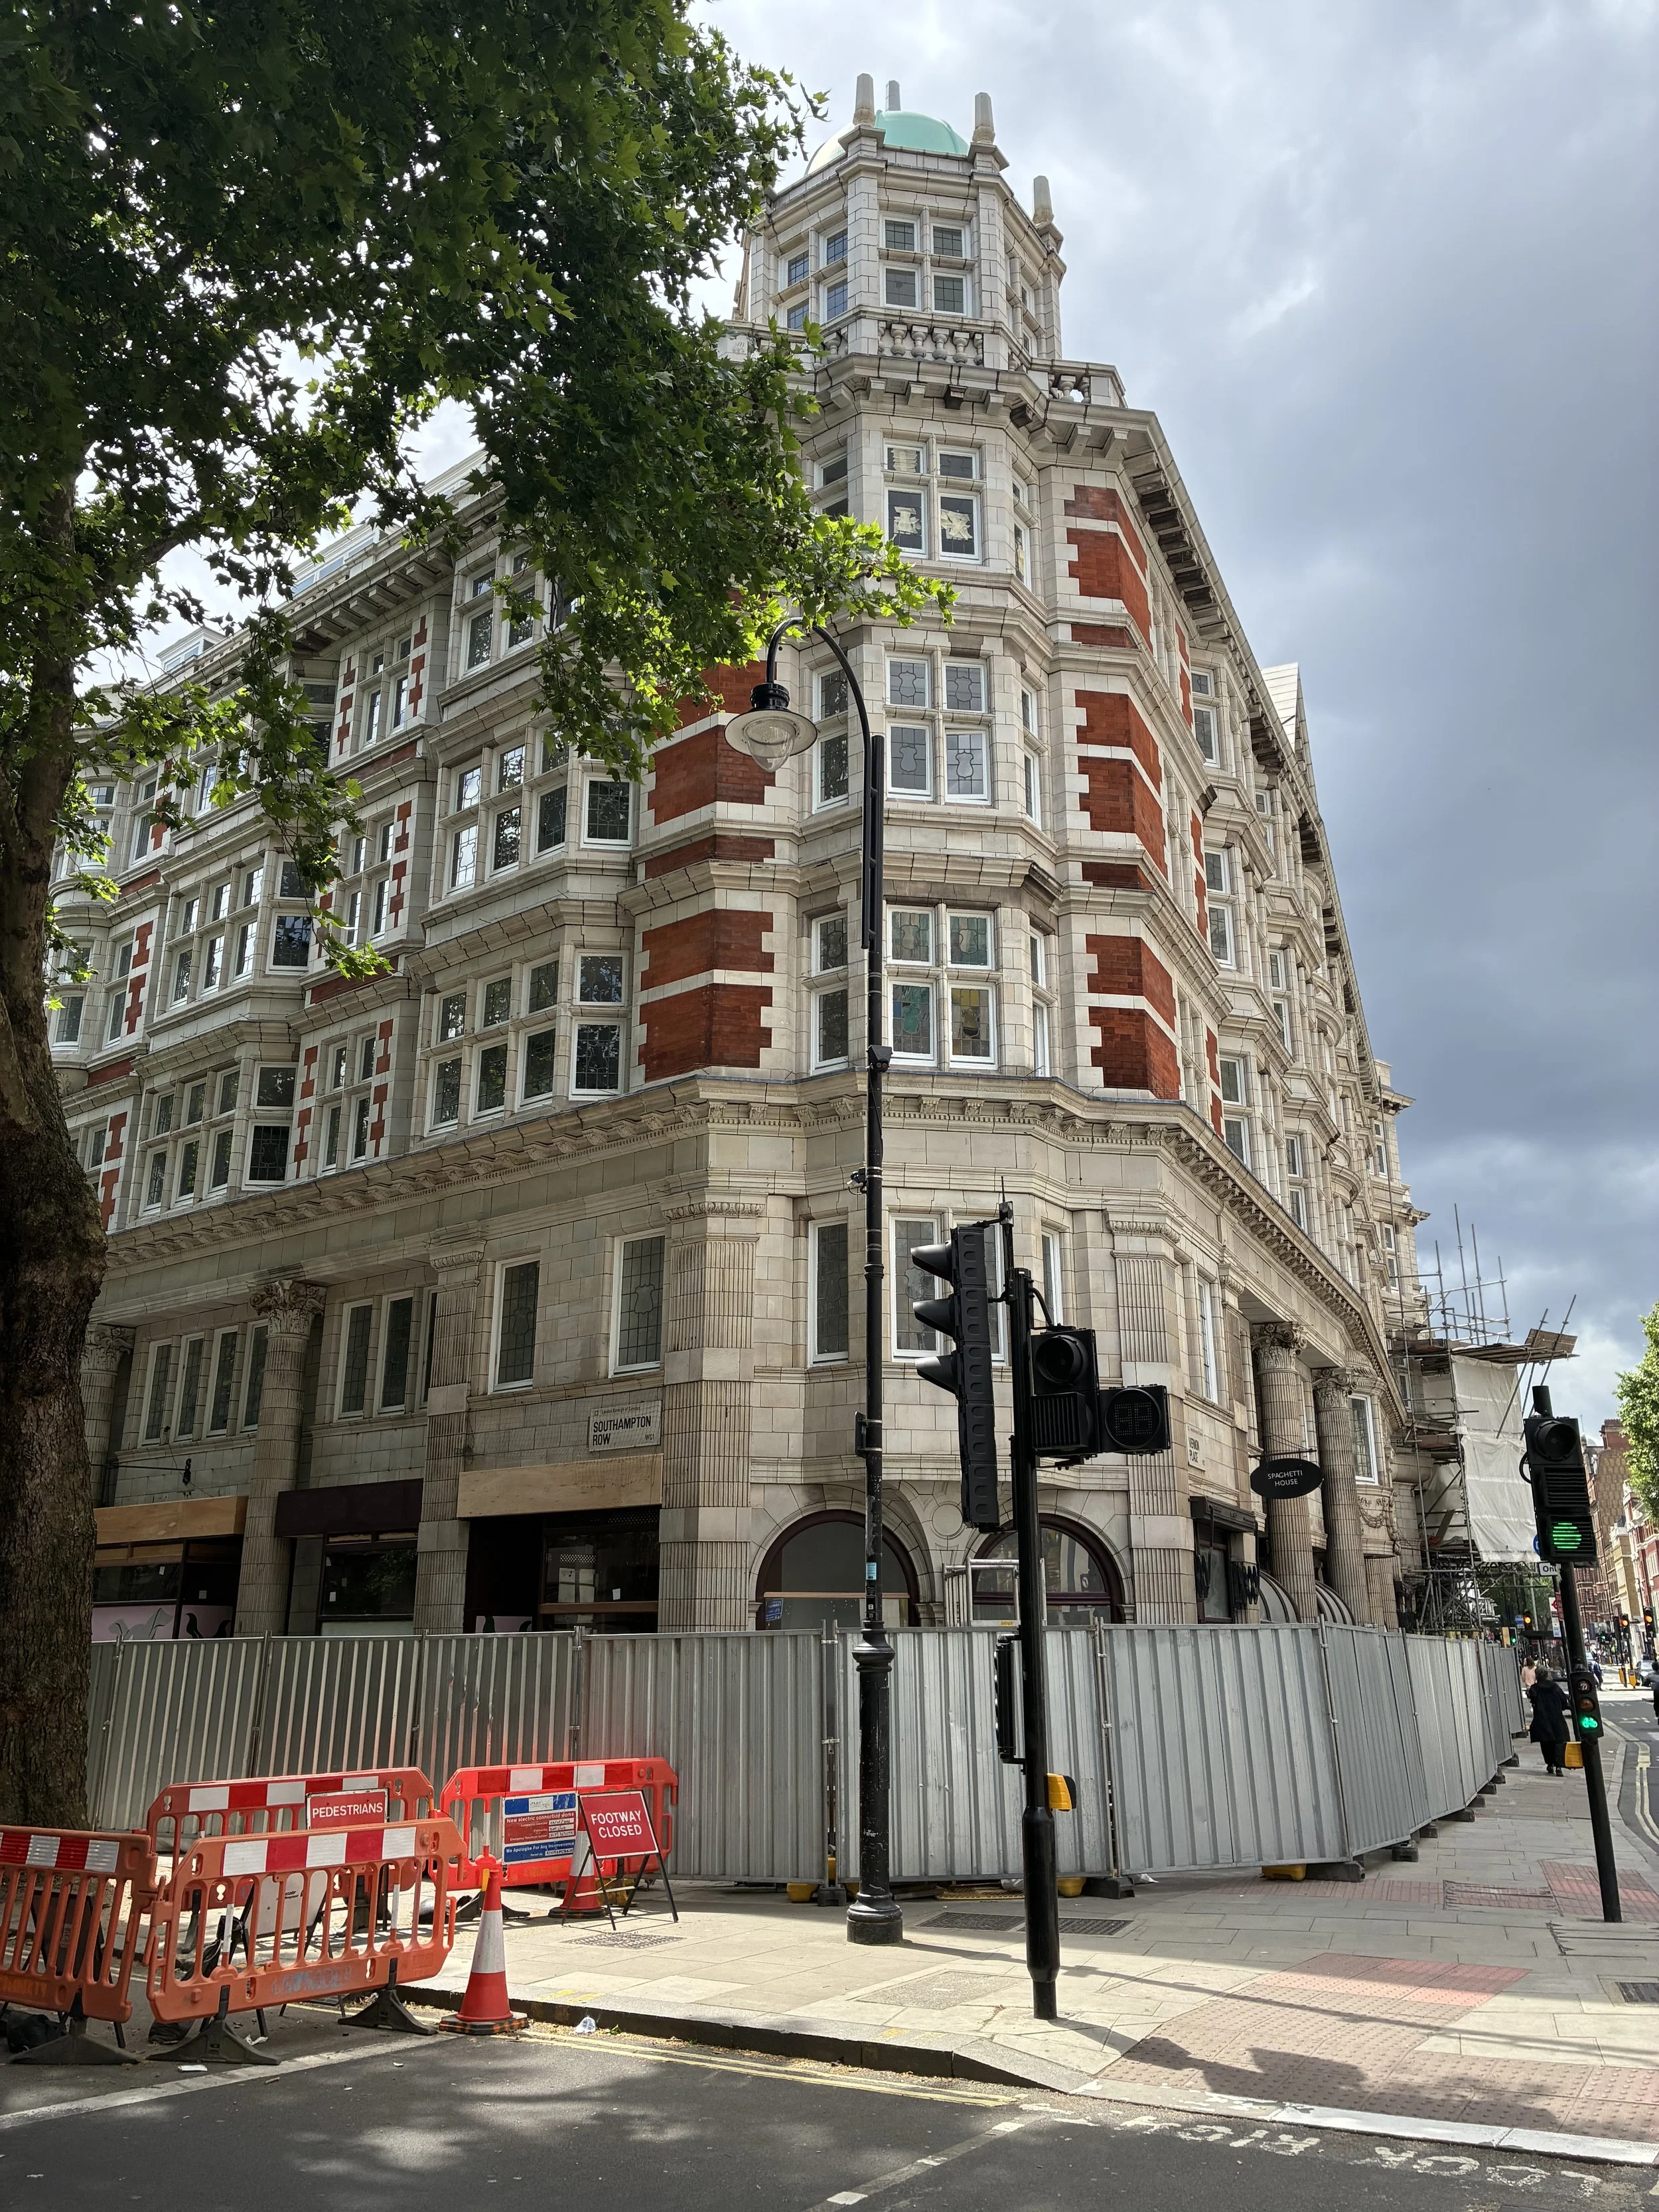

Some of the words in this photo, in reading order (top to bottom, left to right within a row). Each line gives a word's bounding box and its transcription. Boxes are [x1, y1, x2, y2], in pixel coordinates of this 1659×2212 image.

[593, 1415, 652, 1433] SOUTHAMPTON
[593, 1433, 611, 1446] ROW
[1189, 1436, 1200, 1451] VERNON
[1189, 1449, 1198, 1463] PLACE
[1267, 1470, 1303, 1479] SPAGHETTI
[312, 1802, 383, 1818] PEDESTRIANS
[591, 1810, 641, 1825] FOOTWAY
[598, 1824, 642, 1838] CLOSED
